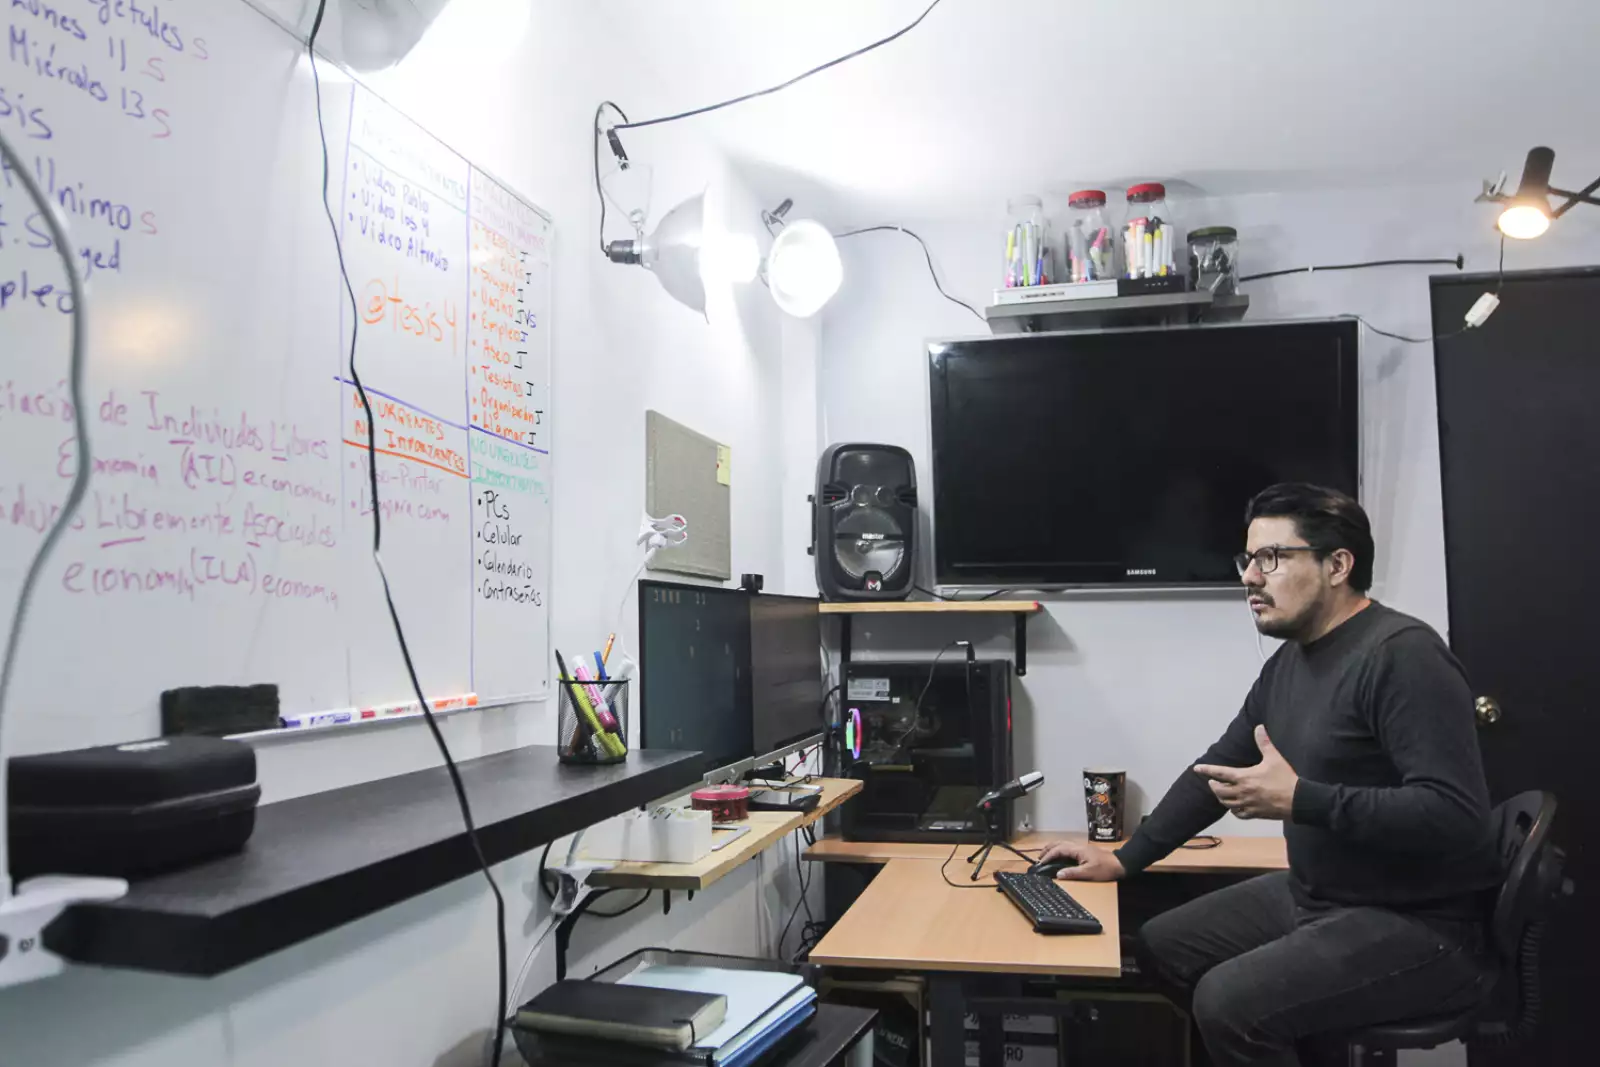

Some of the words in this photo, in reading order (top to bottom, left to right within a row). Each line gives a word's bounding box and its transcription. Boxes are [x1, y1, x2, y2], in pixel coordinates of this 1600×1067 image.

[360, 215, 402, 252] Video
[99, 389, 128, 426] de
[482, 489, 510, 520] PCs
[482, 520, 523, 546] Celular
[482, 549, 533, 580] Calendario
[1126, 568, 1157, 576] SAMSUNG
[482, 578, 542, 607] Contraseñas
